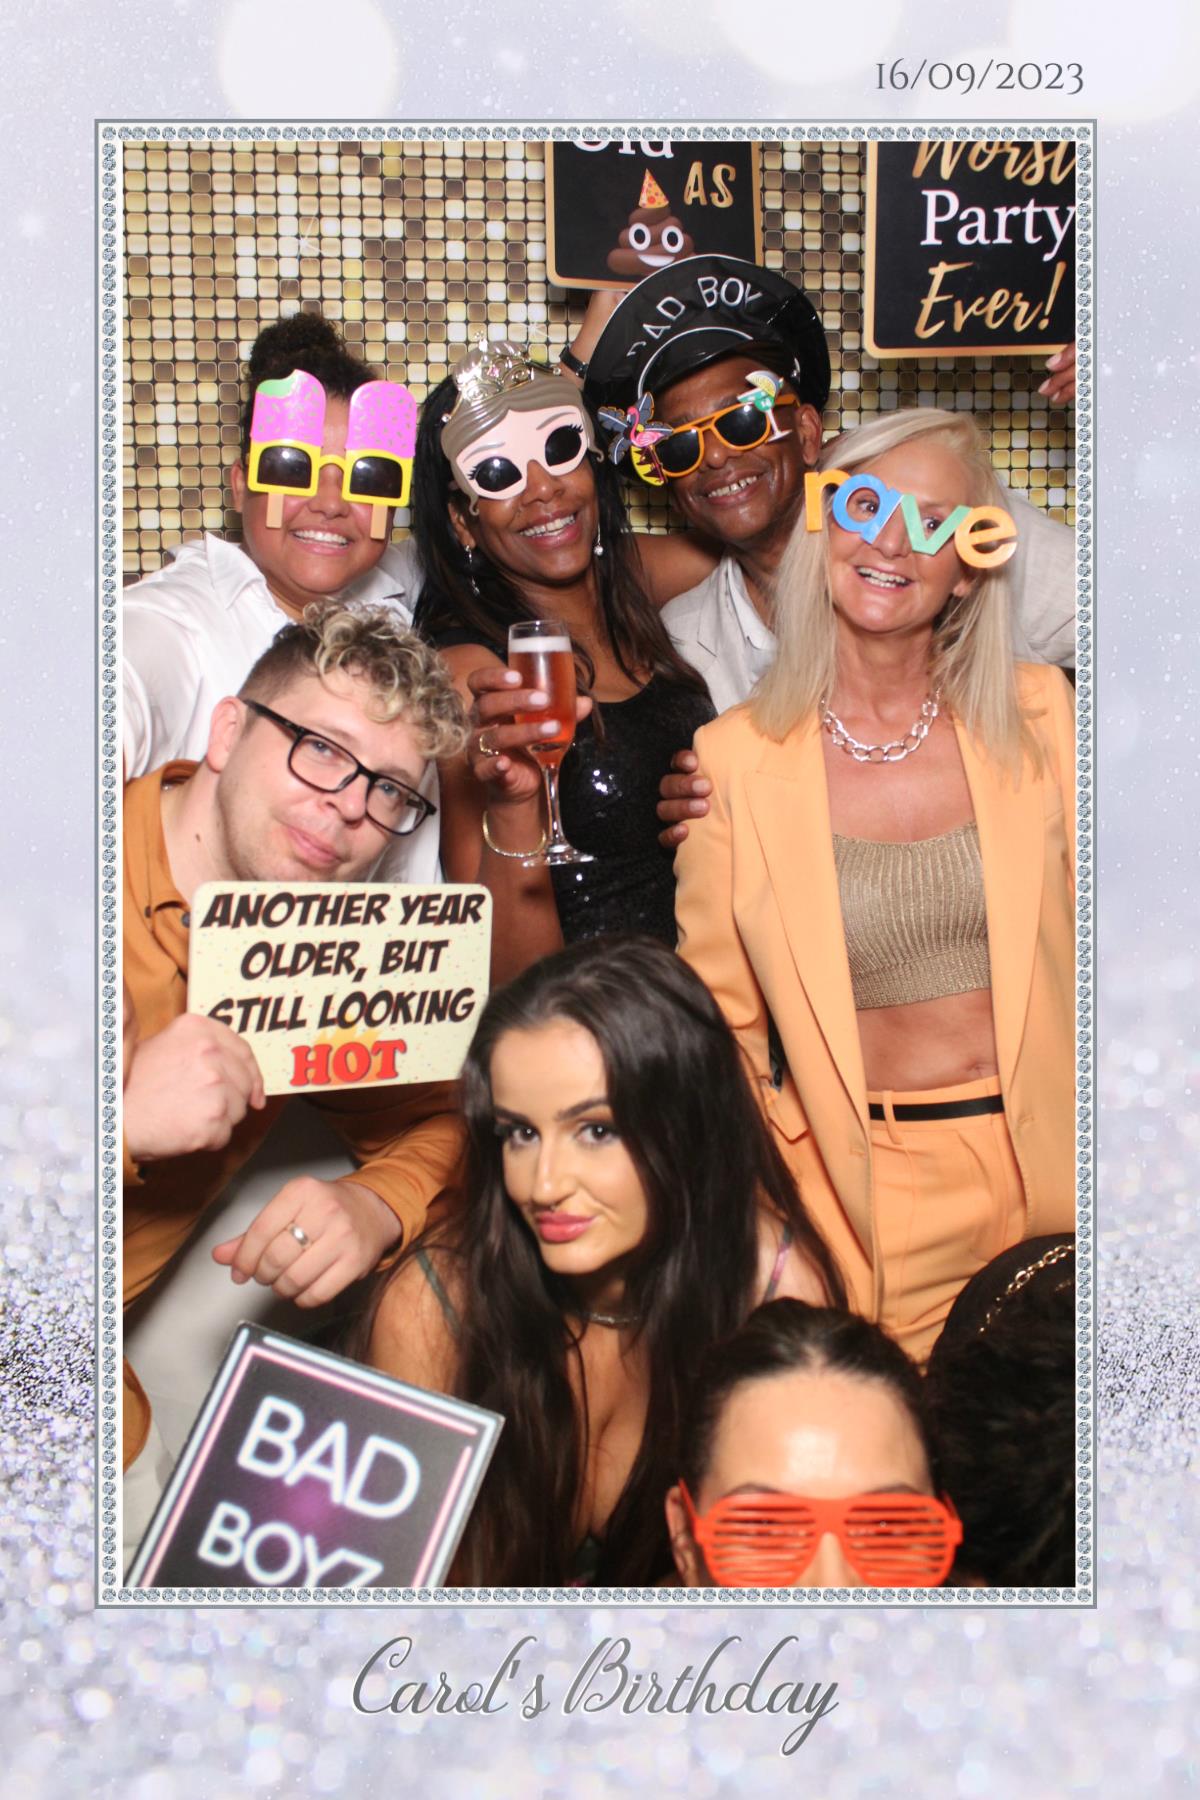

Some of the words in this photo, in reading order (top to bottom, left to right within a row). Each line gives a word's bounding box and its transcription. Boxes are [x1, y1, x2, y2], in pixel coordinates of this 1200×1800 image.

[683, 161, 737, 208] AS
[920, 189, 1076, 262] Party
[915, 261, 1066, 339] Ever!
[804, 469, 1018, 569] rave
[200, 892, 391, 929] ANOTHER
[399, 893, 486, 926] YEAR
[240, 941, 367, 982] OLDER,
[379, 939, 449, 975] BUT
[206, 994, 307, 1034] STILL
[317, 987, 475, 1029] LOOKING
[290, 1039, 407, 1087] HOT
[237, 1395, 421, 1519] BAD
